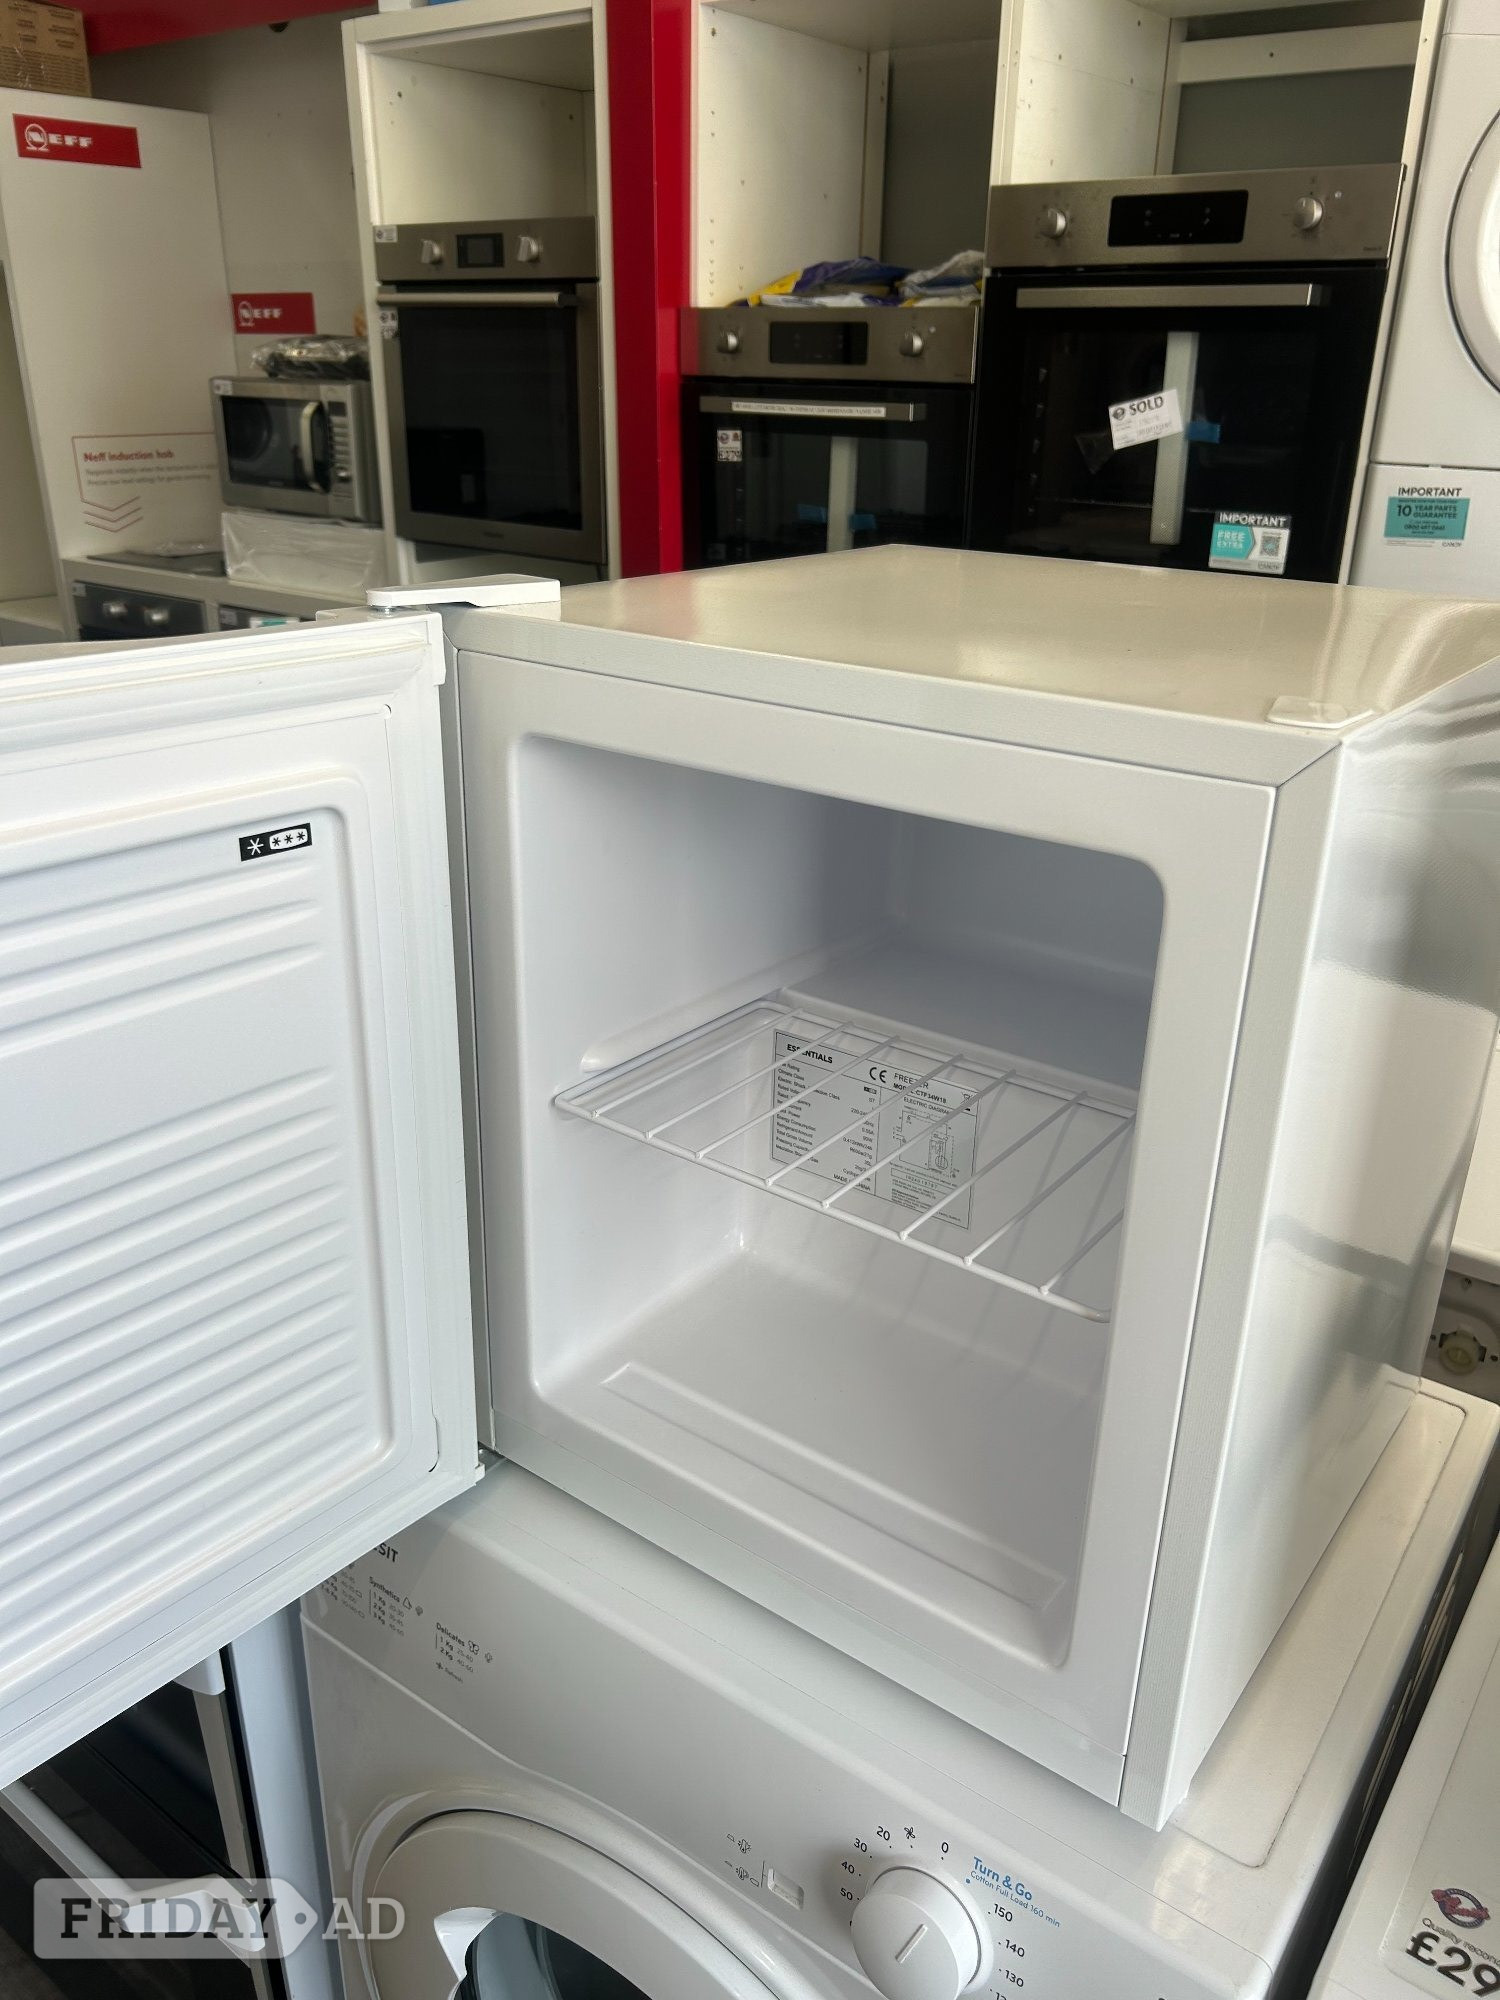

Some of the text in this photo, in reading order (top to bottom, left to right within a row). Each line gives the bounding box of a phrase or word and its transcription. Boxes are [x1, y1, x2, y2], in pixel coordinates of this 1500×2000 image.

[25, 126, 93, 149] NEFF
[238, 304, 283, 323] NEFF
[1129, 396, 1164, 416] SOLD
[83, 452, 106, 462] Neff
[108, 451, 154, 461] induction
[1398, 487, 1462, 497] IMPORTANT
[1220, 512, 1287, 527] IMPORTANT
[1397, 504, 1412, 517] 10
[1218, 530, 1245, 541] FREE
[787, 1043, 833, 1064] ESNTIALS
[893, 1072, 928, 1089] FREER
[374, 1542, 399, 1562] SIT
[369, 1576, 400, 1602] Synthetics
[436, 1622, 465, 1647] Delicates
[876, 1826, 890, 1841] 20
[853, 1837, 868, 1853] 30
[941, 1841, 949, 1854] 0
[841, 1861, 855, 1875] 40
[973, 1856, 1033, 1901] Turn & Go
[839, 1887, 854, 1901] 50
[970, 1870, 1062, 1928] Cotton Full Load 160 min
[993, 1903, 1013, 1923] 150
[1422, 1917, 1462, 1944] Quality
[1005, 1939, 1026, 1958] 140
[1005, 1970, 1024, 1988] 130
